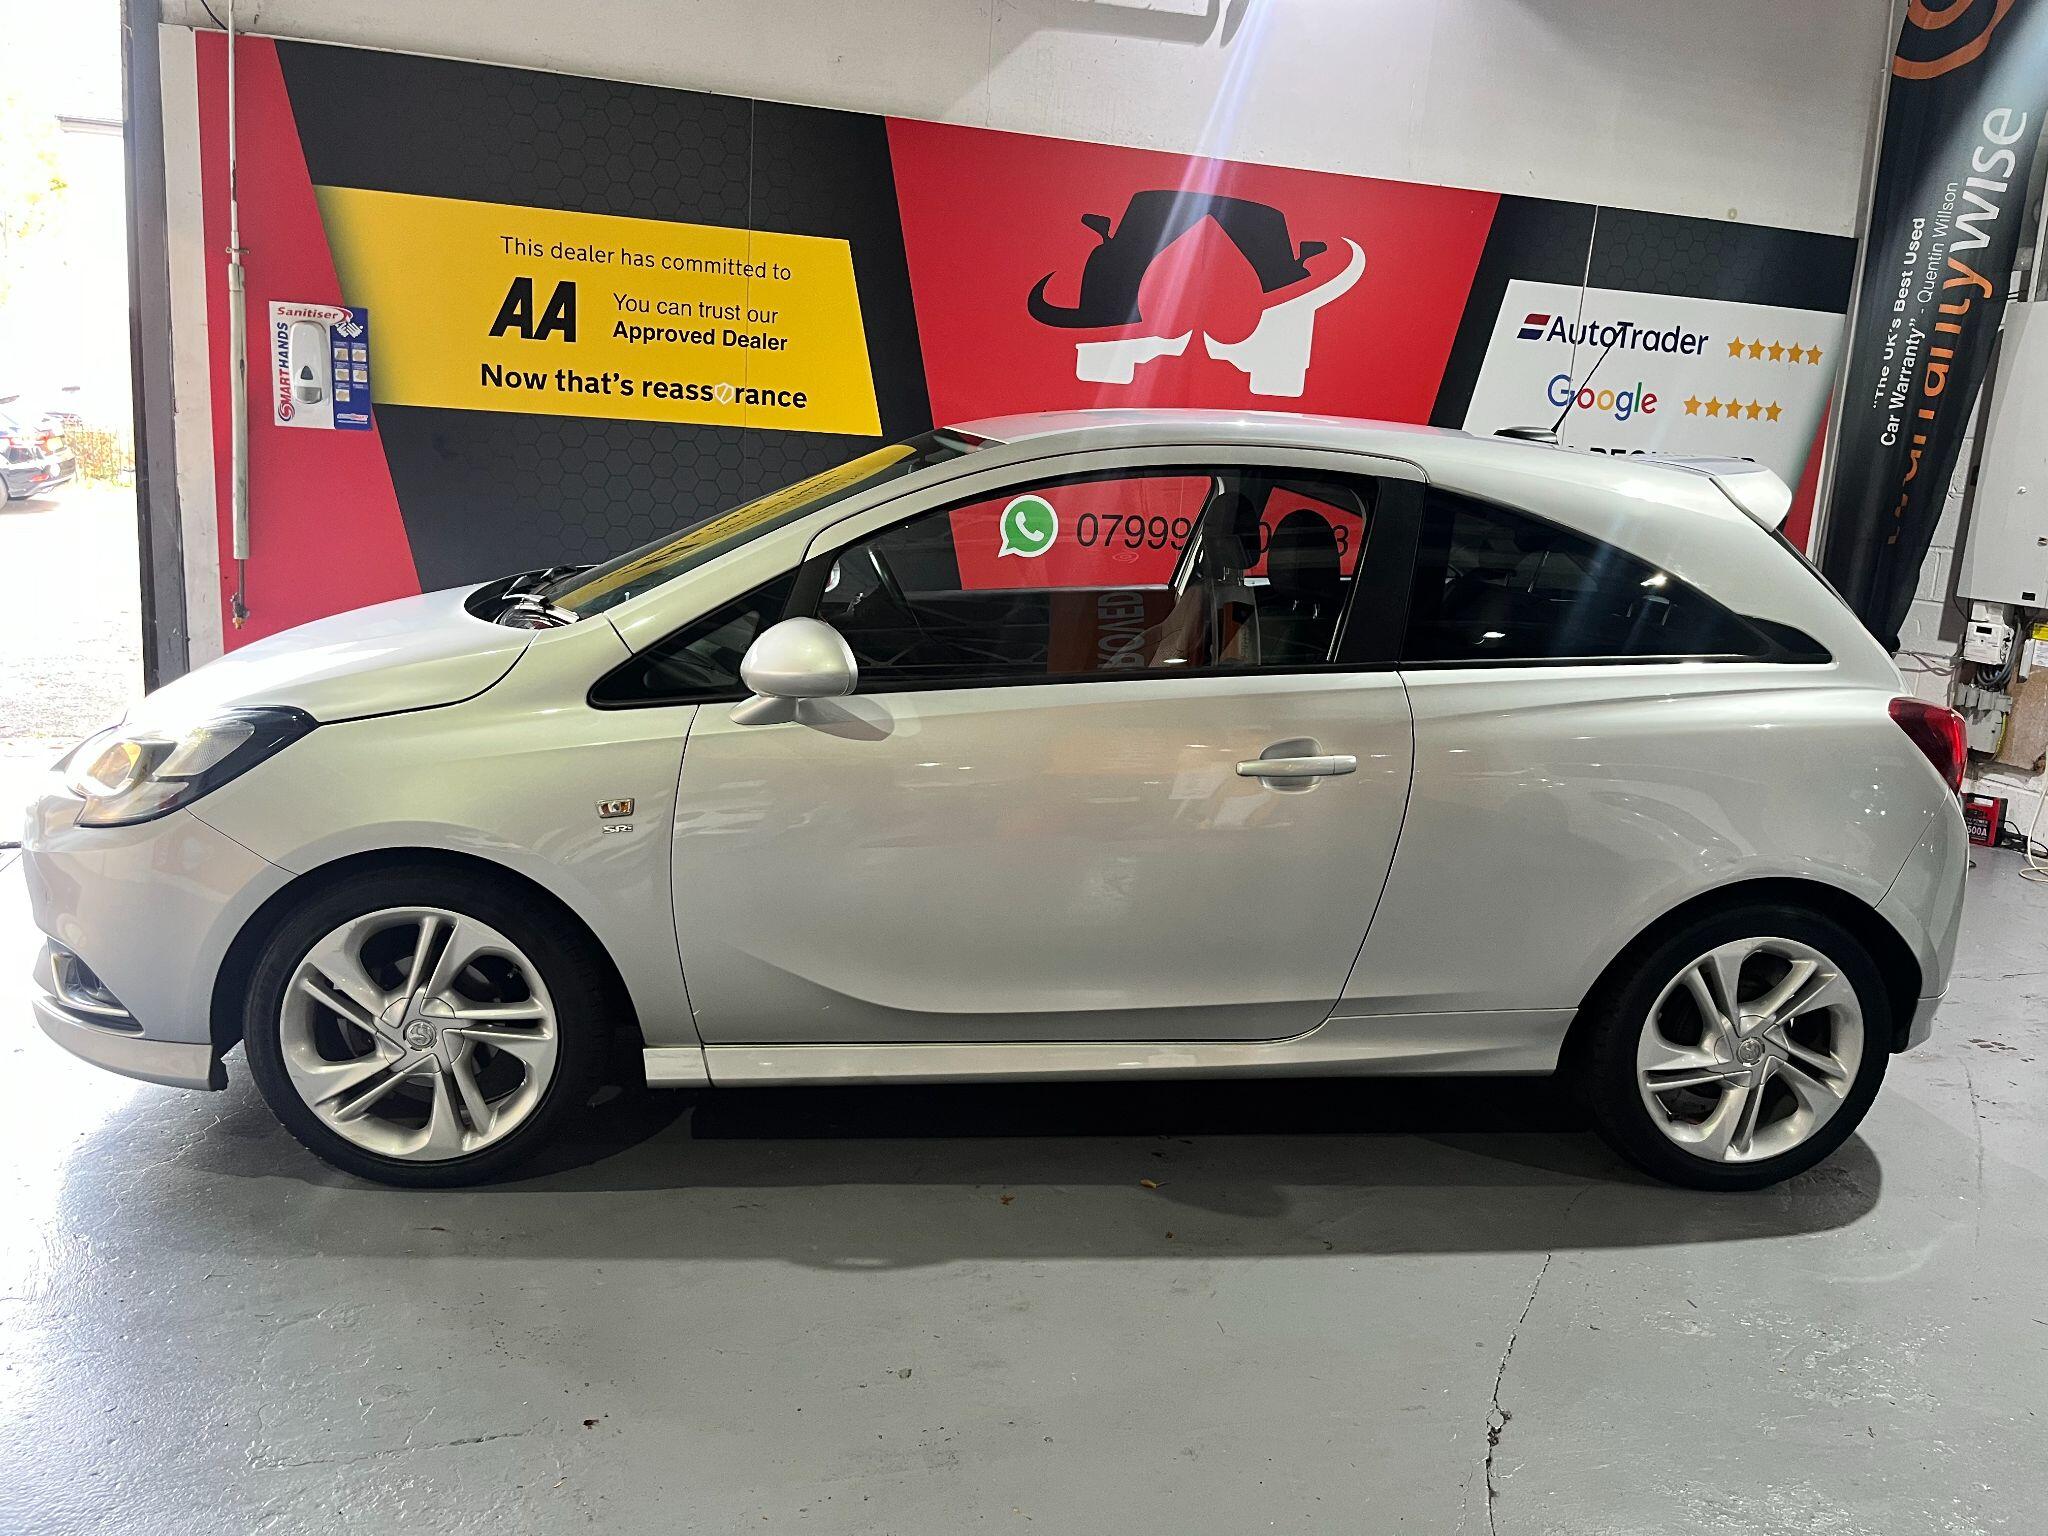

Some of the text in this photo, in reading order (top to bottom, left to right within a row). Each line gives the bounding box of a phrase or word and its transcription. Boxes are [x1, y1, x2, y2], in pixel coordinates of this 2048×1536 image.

[500, 235, 791, 281] This dealer has committed to
[1903, 217, 1926, 265] Used
[277, 306, 339, 320] Sanitiser
[488, 276, 577, 343] AA
[613, 292, 779, 324] You can trust our
[1893, 269, 1914, 312] Best
[613, 320, 788, 352] Approved Dealer
[1546, 315, 1709, 355] AutoTrader
[1880, 414, 1901, 447] Car
[1916, 243, 1945, 304] Quentin
[1932, 182, 1958, 238] Willson
[481, 363, 548, 391] Now
[642, 376, 808, 409] reassrance
[1547, 373, 1658, 421] Google
